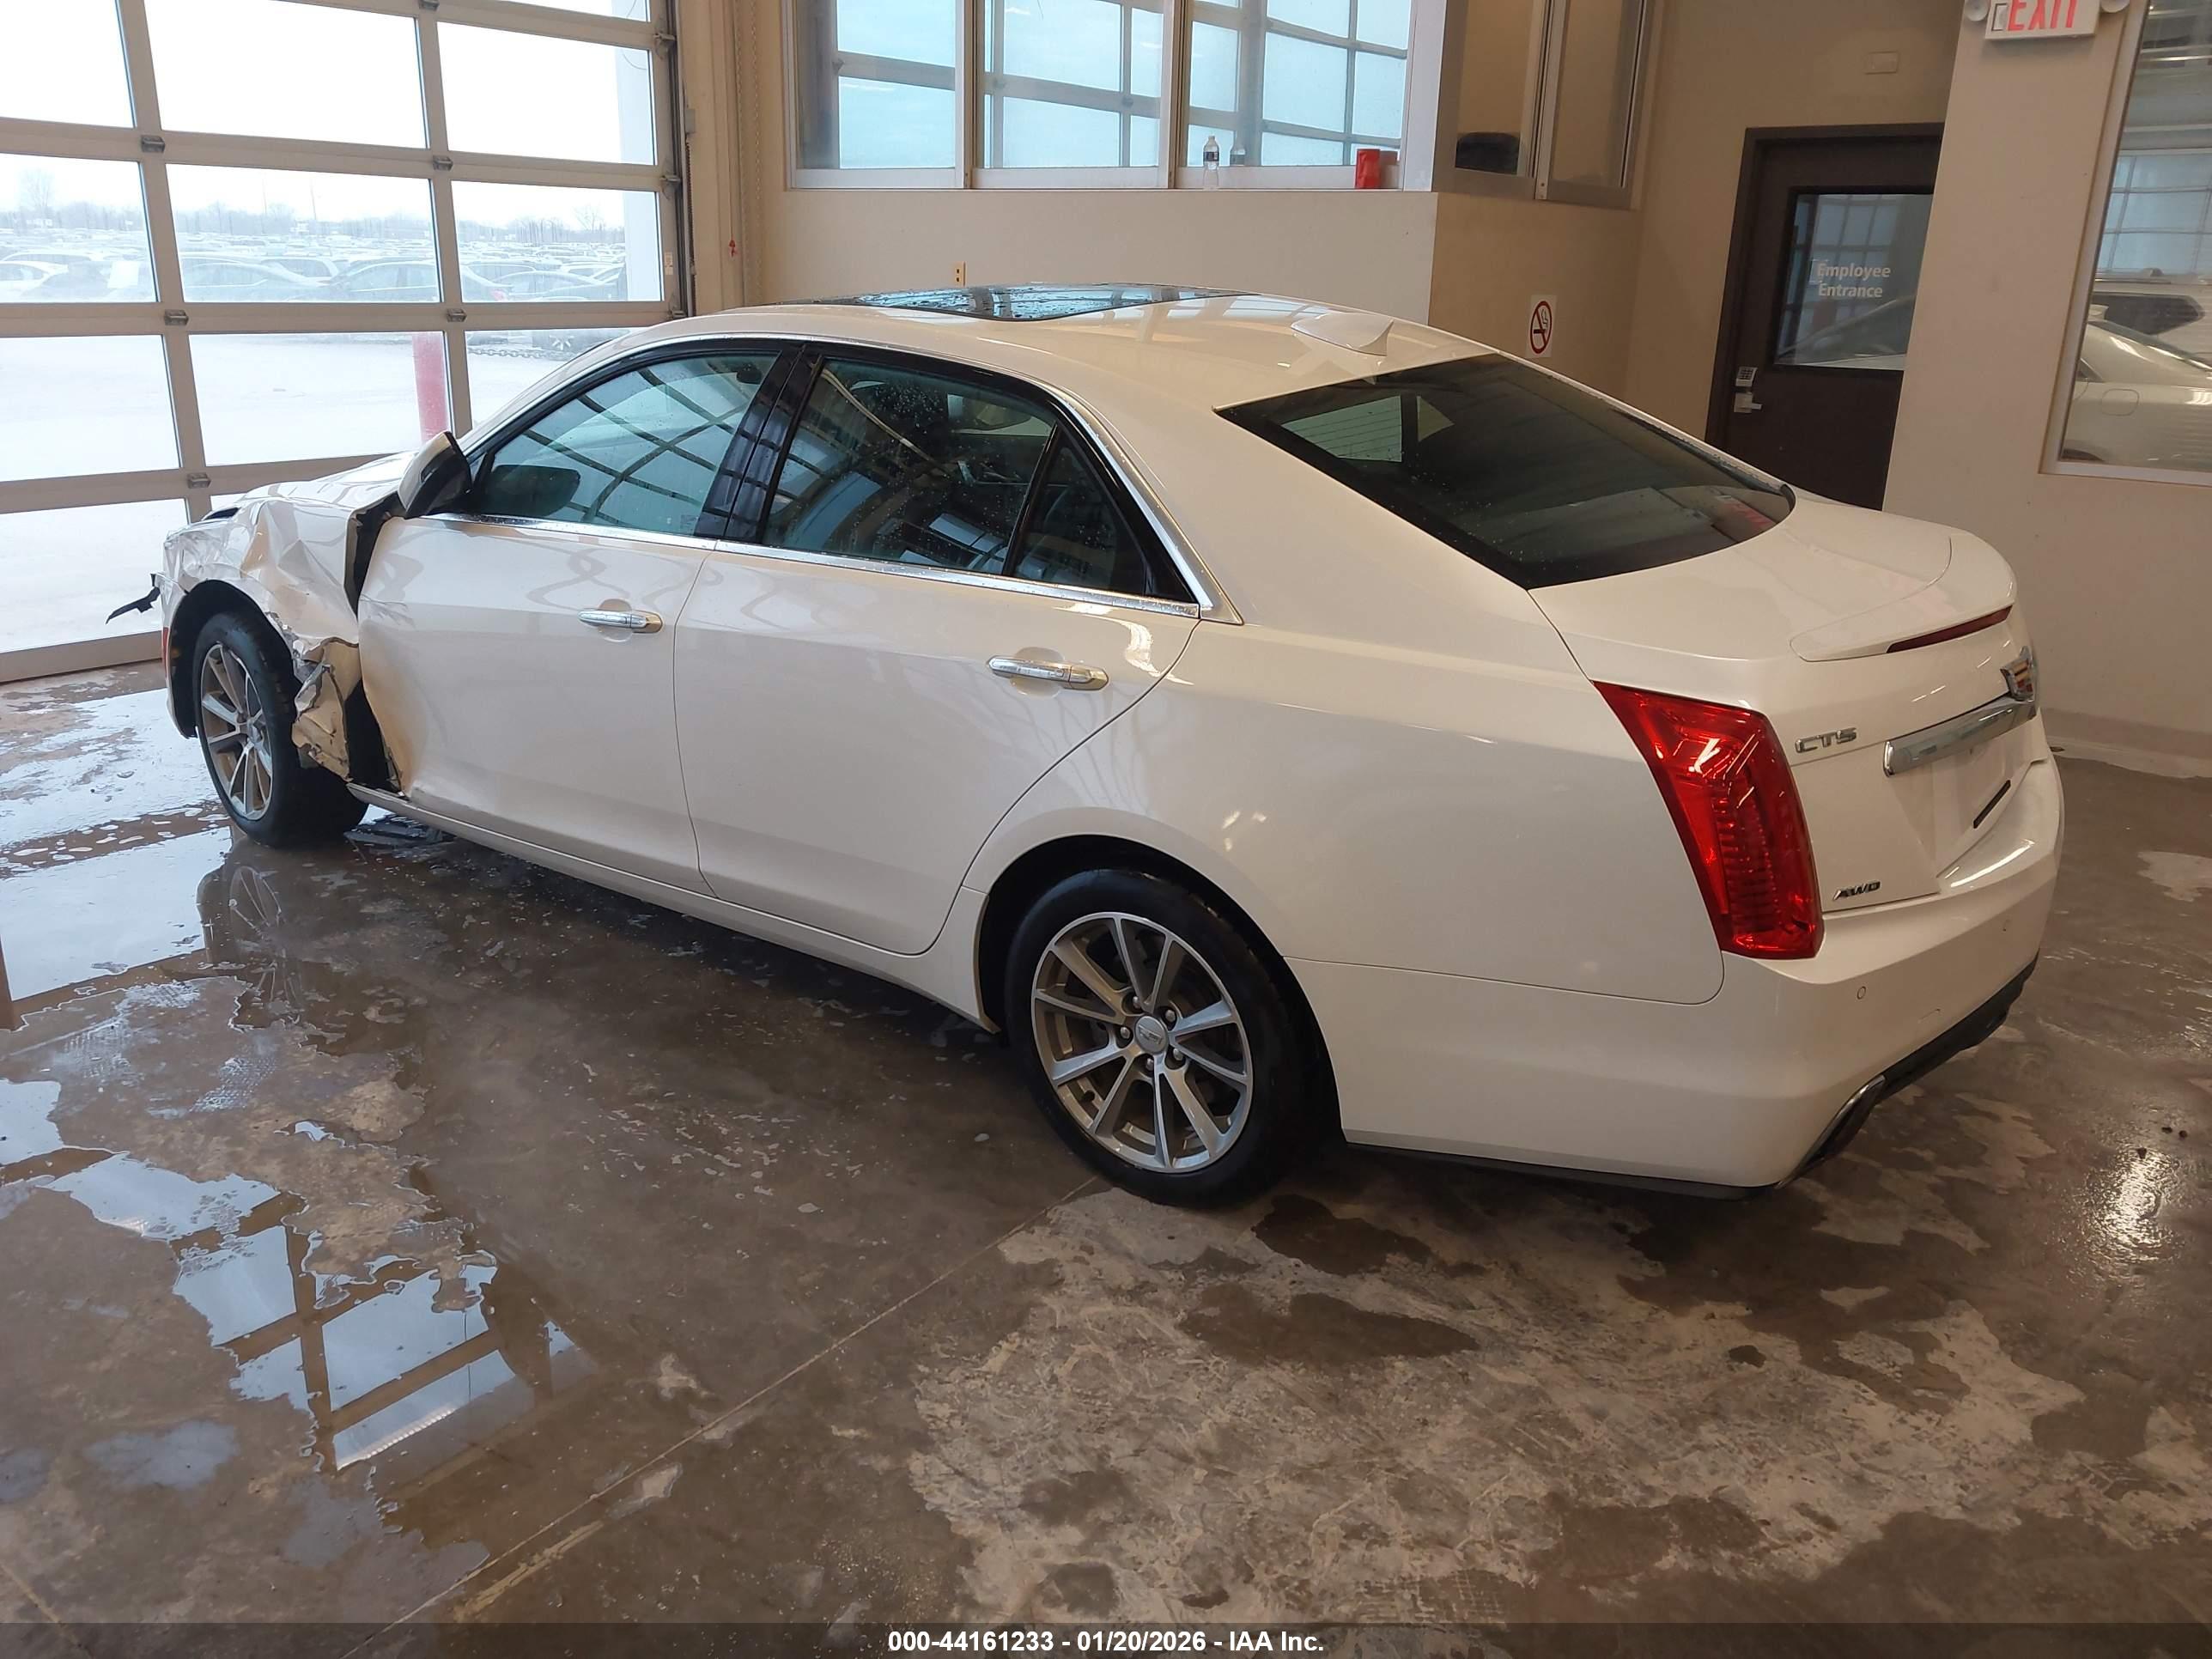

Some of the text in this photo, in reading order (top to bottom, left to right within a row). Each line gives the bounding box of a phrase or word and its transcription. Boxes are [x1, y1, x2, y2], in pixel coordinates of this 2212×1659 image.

[1816, 262, 1892, 282] Employee
[1818, 283, 1884, 298] Entrance
[1794, 726, 1857, 754] CTS
[1832, 881, 1881, 901] AWD
